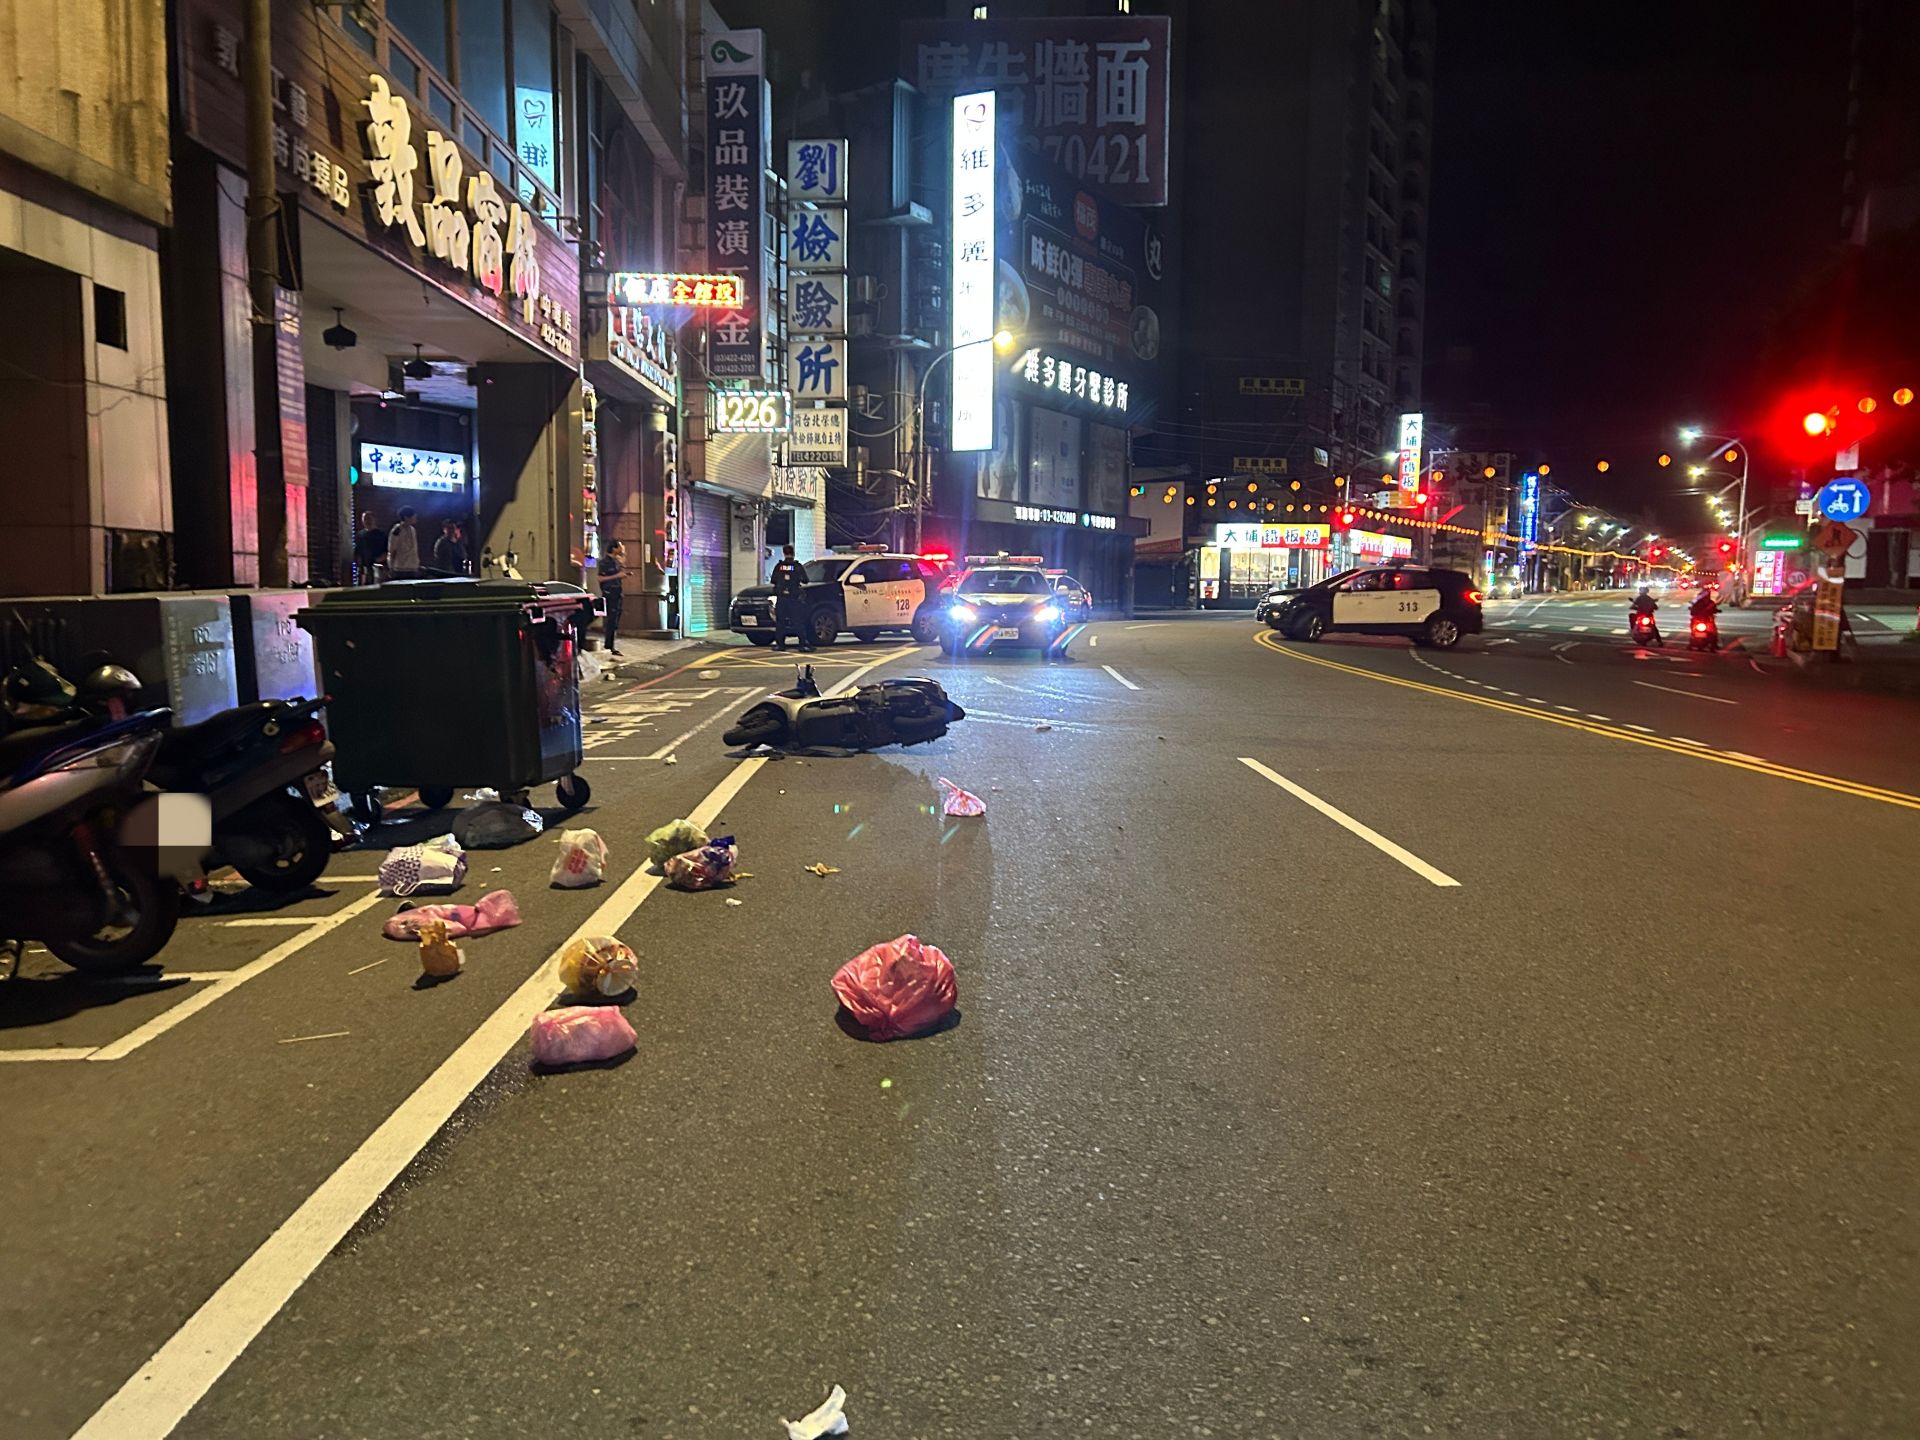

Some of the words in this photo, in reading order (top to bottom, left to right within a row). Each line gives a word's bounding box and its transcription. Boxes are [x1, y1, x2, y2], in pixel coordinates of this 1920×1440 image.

[1021, 134, 1151, 184] 70421
[791, 142, 840, 395] 劉檢驗所
[958, 146, 990, 422] 維多麗牙所
[1023, 348, 1129, 412] 維多麗牙醫診所
[895, 599, 910, 611] 128
[1398, 602, 1419, 612] 313
